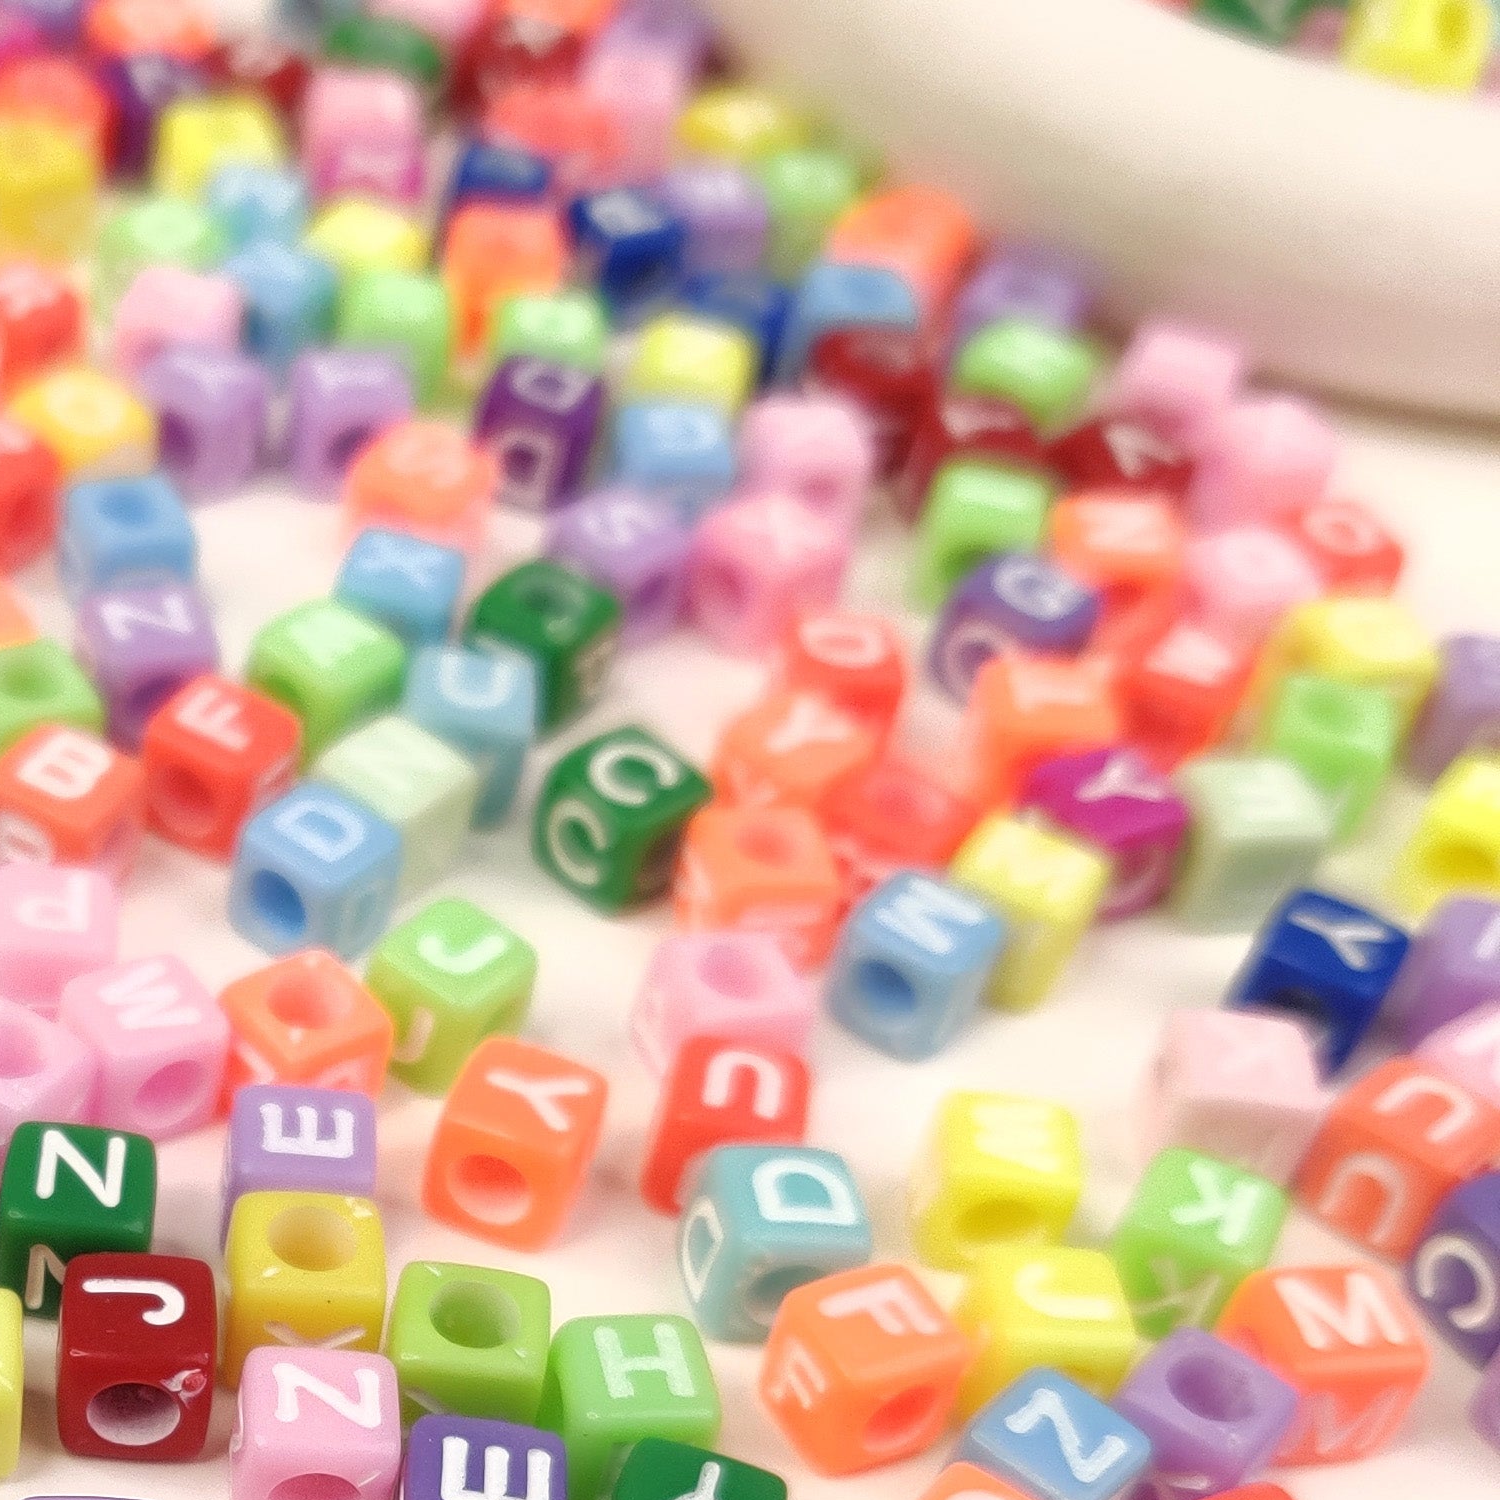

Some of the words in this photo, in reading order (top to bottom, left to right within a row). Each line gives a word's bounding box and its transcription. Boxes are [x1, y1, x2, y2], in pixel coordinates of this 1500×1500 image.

[171, 687, 254, 751] F
[16, 734, 114, 799] B
[586, 743, 682, 806] C
[272, 798, 367, 863] D
[546, 799, 607, 886] C
[416, 929, 509, 976] J
[1290, 908, 1390, 971] Y
[485, 1070, 591, 1132] Y
[702, 1050, 783, 1121] U
[1374, 1074, 1475, 1144] U
[260, 1102, 355, 1160] E
[35, 1129, 127, 1208] N
[751, 1158, 860, 1226] D
[1316, 1151, 1401, 1246] U
[1170, 1158, 1264, 1246] K
[82, 1277, 186, 1326] J
[819, 1277, 942, 1336] F
[1014, 1261, 1118, 1322] J
[1272, 1272, 1404, 1351] M
[1415, 1234, 1498, 1332] C
[593, 1321, 696, 1399] H
